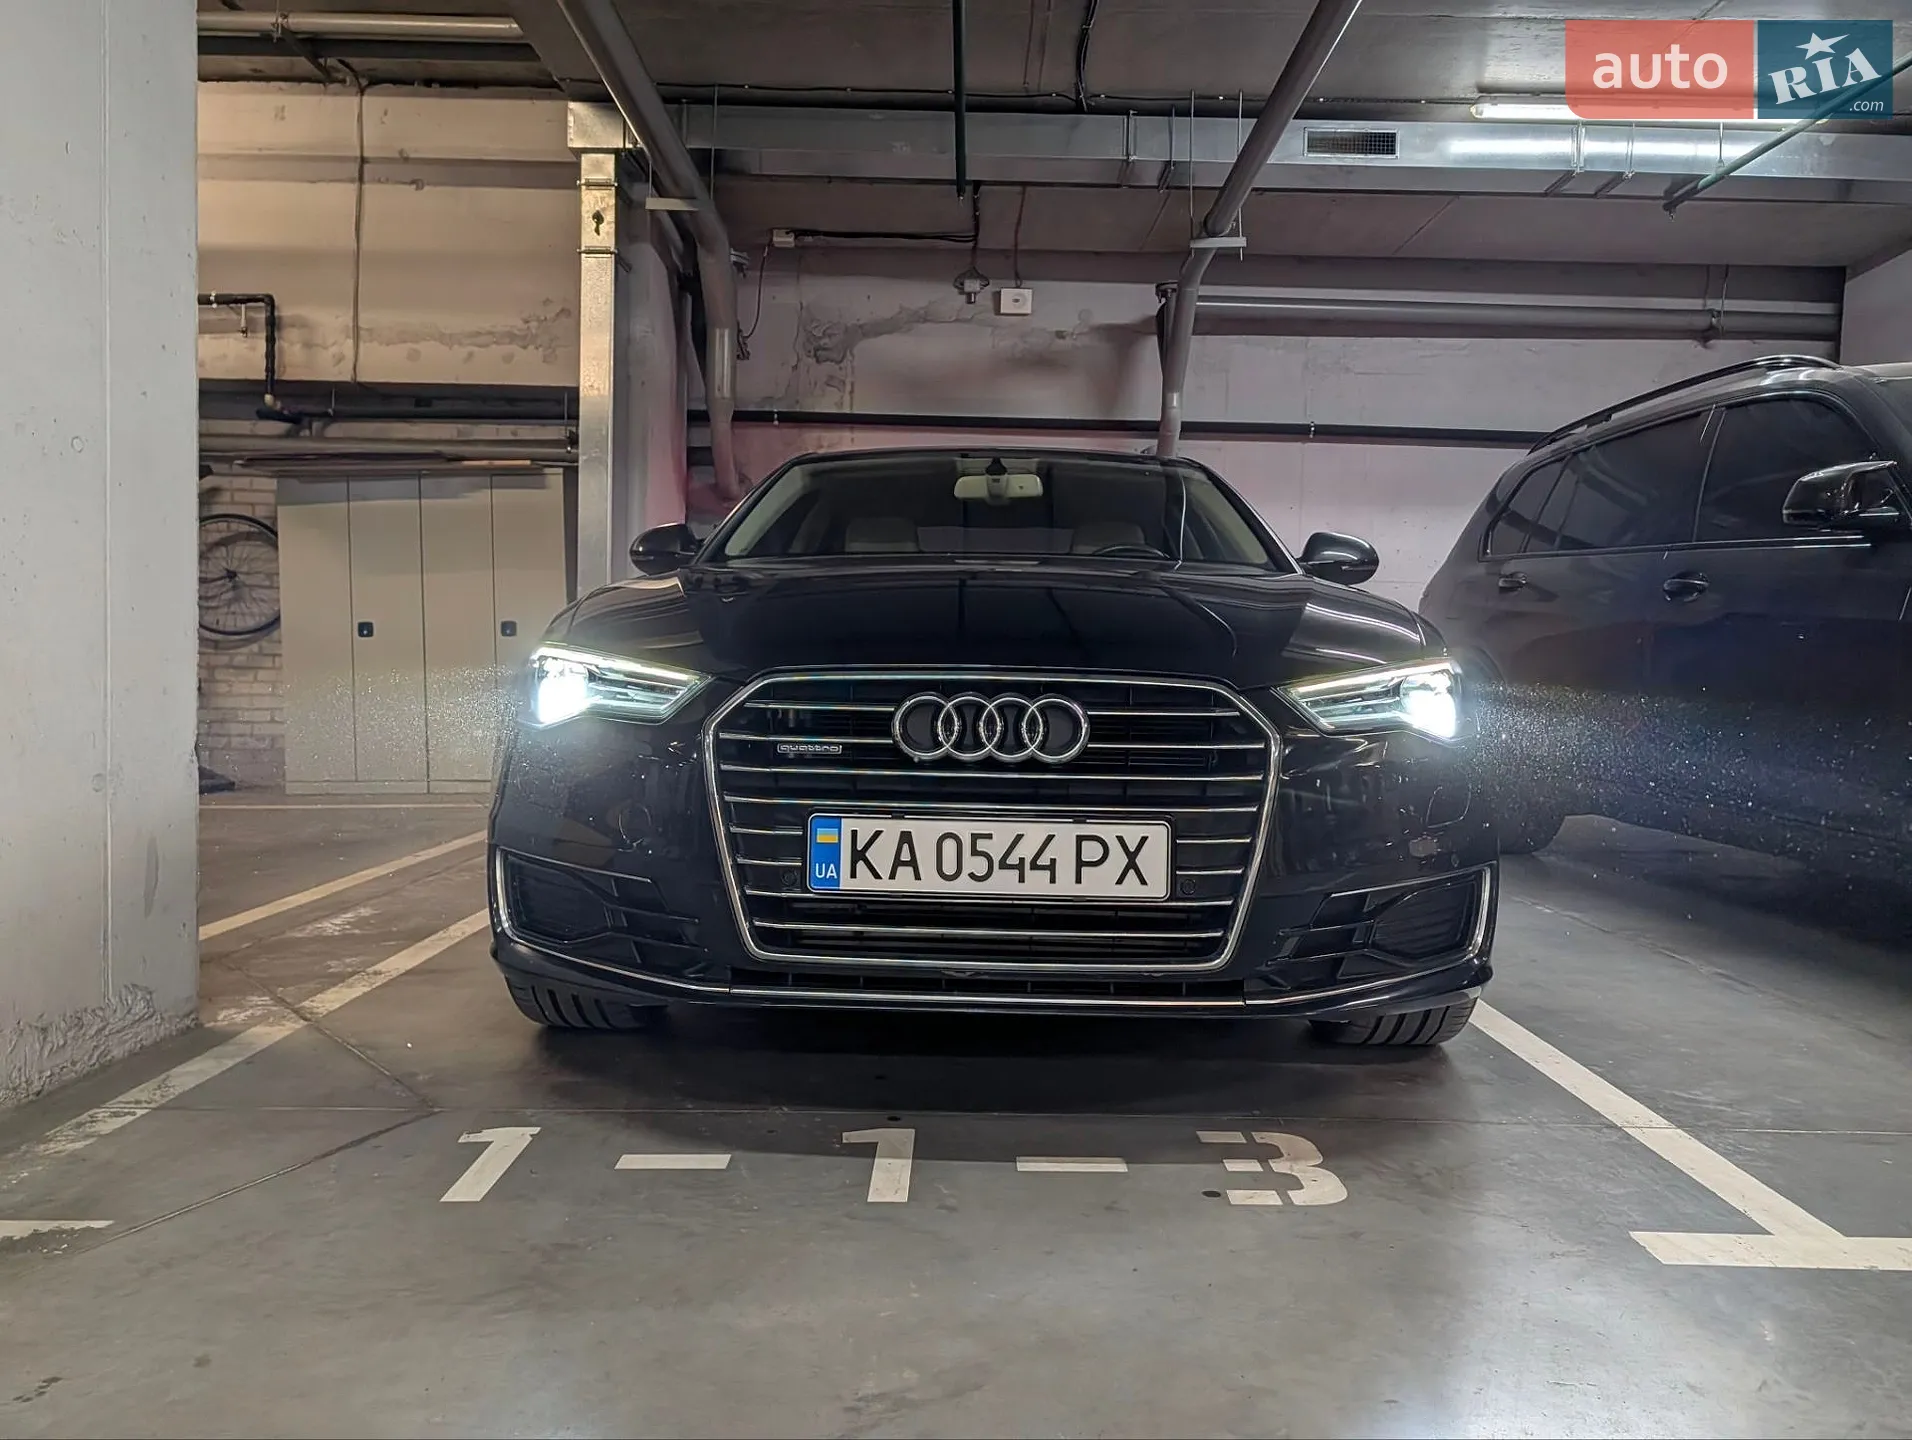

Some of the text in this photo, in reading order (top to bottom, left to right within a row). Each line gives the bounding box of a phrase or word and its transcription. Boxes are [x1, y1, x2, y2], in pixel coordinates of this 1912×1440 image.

[779, 744, 839, 754] quattro
[849, 828, 1149, 886] KA 0544 PX
[815, 863, 838, 879] UA
